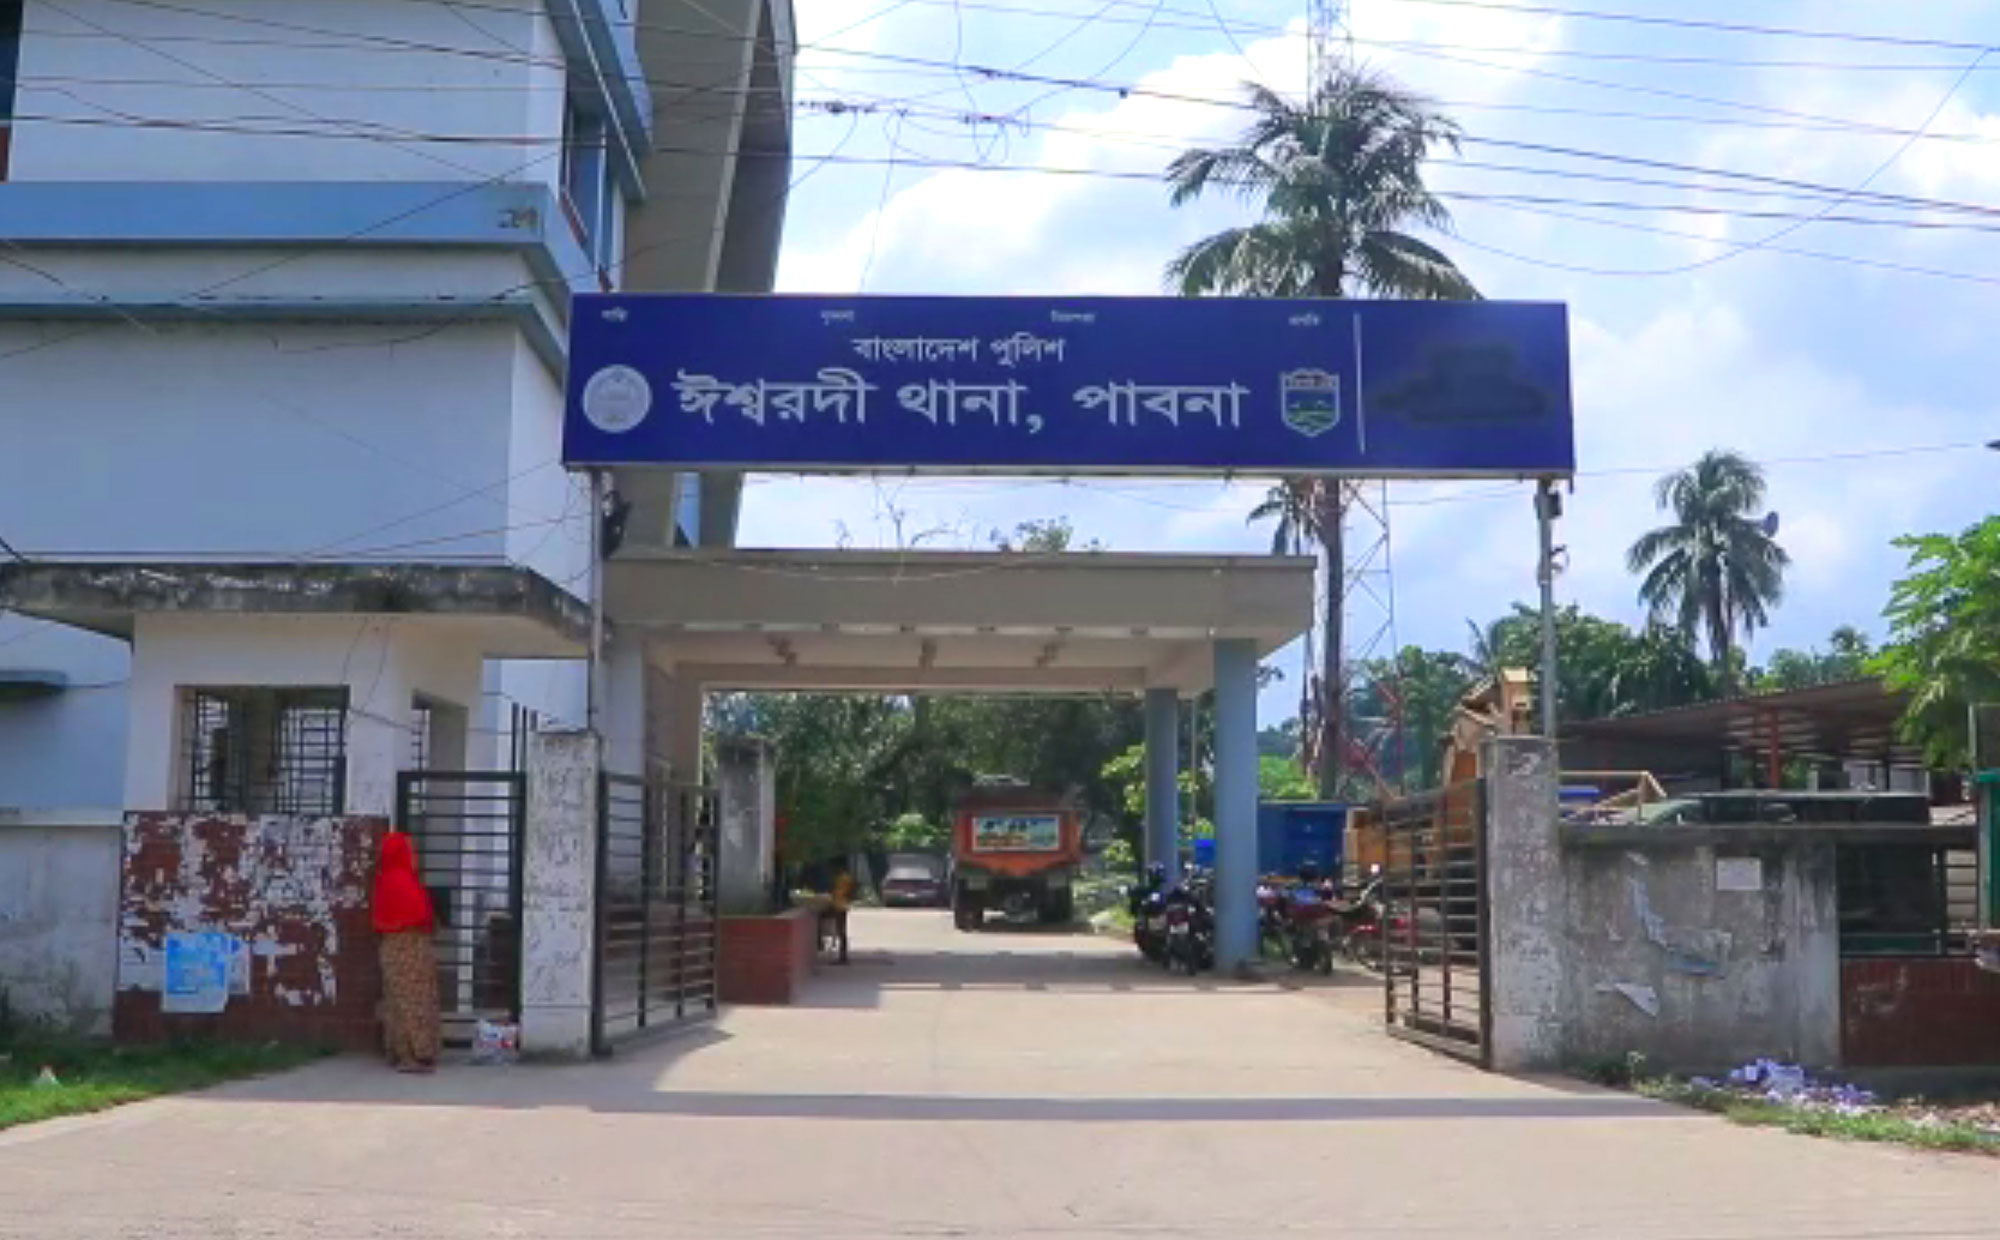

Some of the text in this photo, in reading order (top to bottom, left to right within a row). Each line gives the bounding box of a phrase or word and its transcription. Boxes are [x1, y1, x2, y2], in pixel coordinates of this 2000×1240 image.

[852, 331, 1066, 368] বাংলাদেশ পুলিশ
[670, 367, 1250, 434] ঈশ্বরদী থানা, পাবনা
